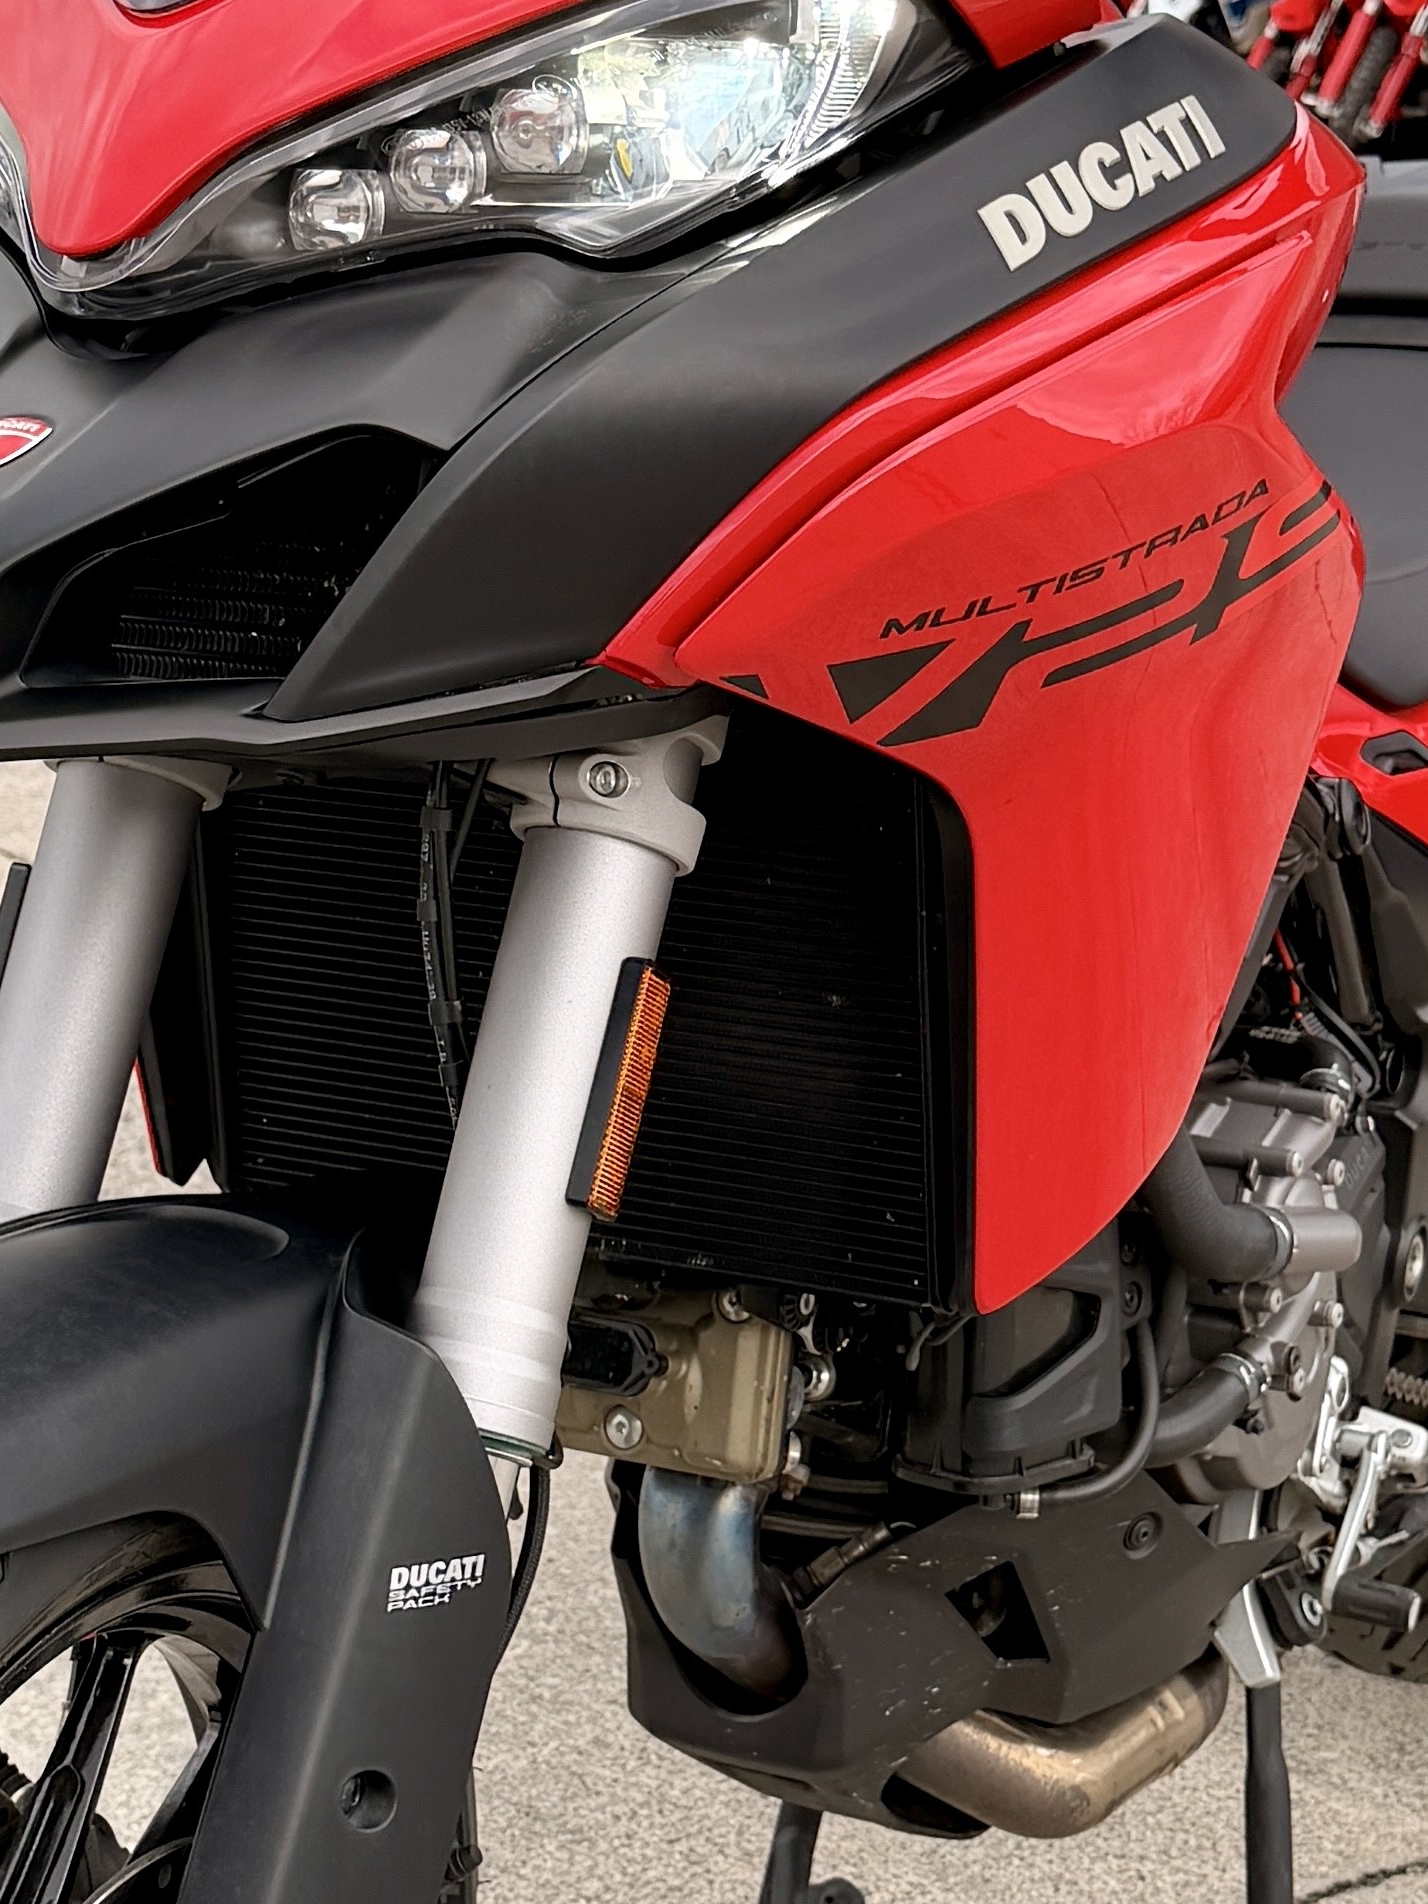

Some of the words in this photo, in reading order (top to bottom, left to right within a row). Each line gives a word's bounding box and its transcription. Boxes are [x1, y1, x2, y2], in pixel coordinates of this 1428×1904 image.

[977, 94, 1226, 272] DUCATI
[879, 478, 1269, 640] MULTISTRADA
[387, 1577, 483, 1602] SAFETY
[389, 1553, 486, 1591] DUCATI
[386, 1593, 451, 1613] PACK
